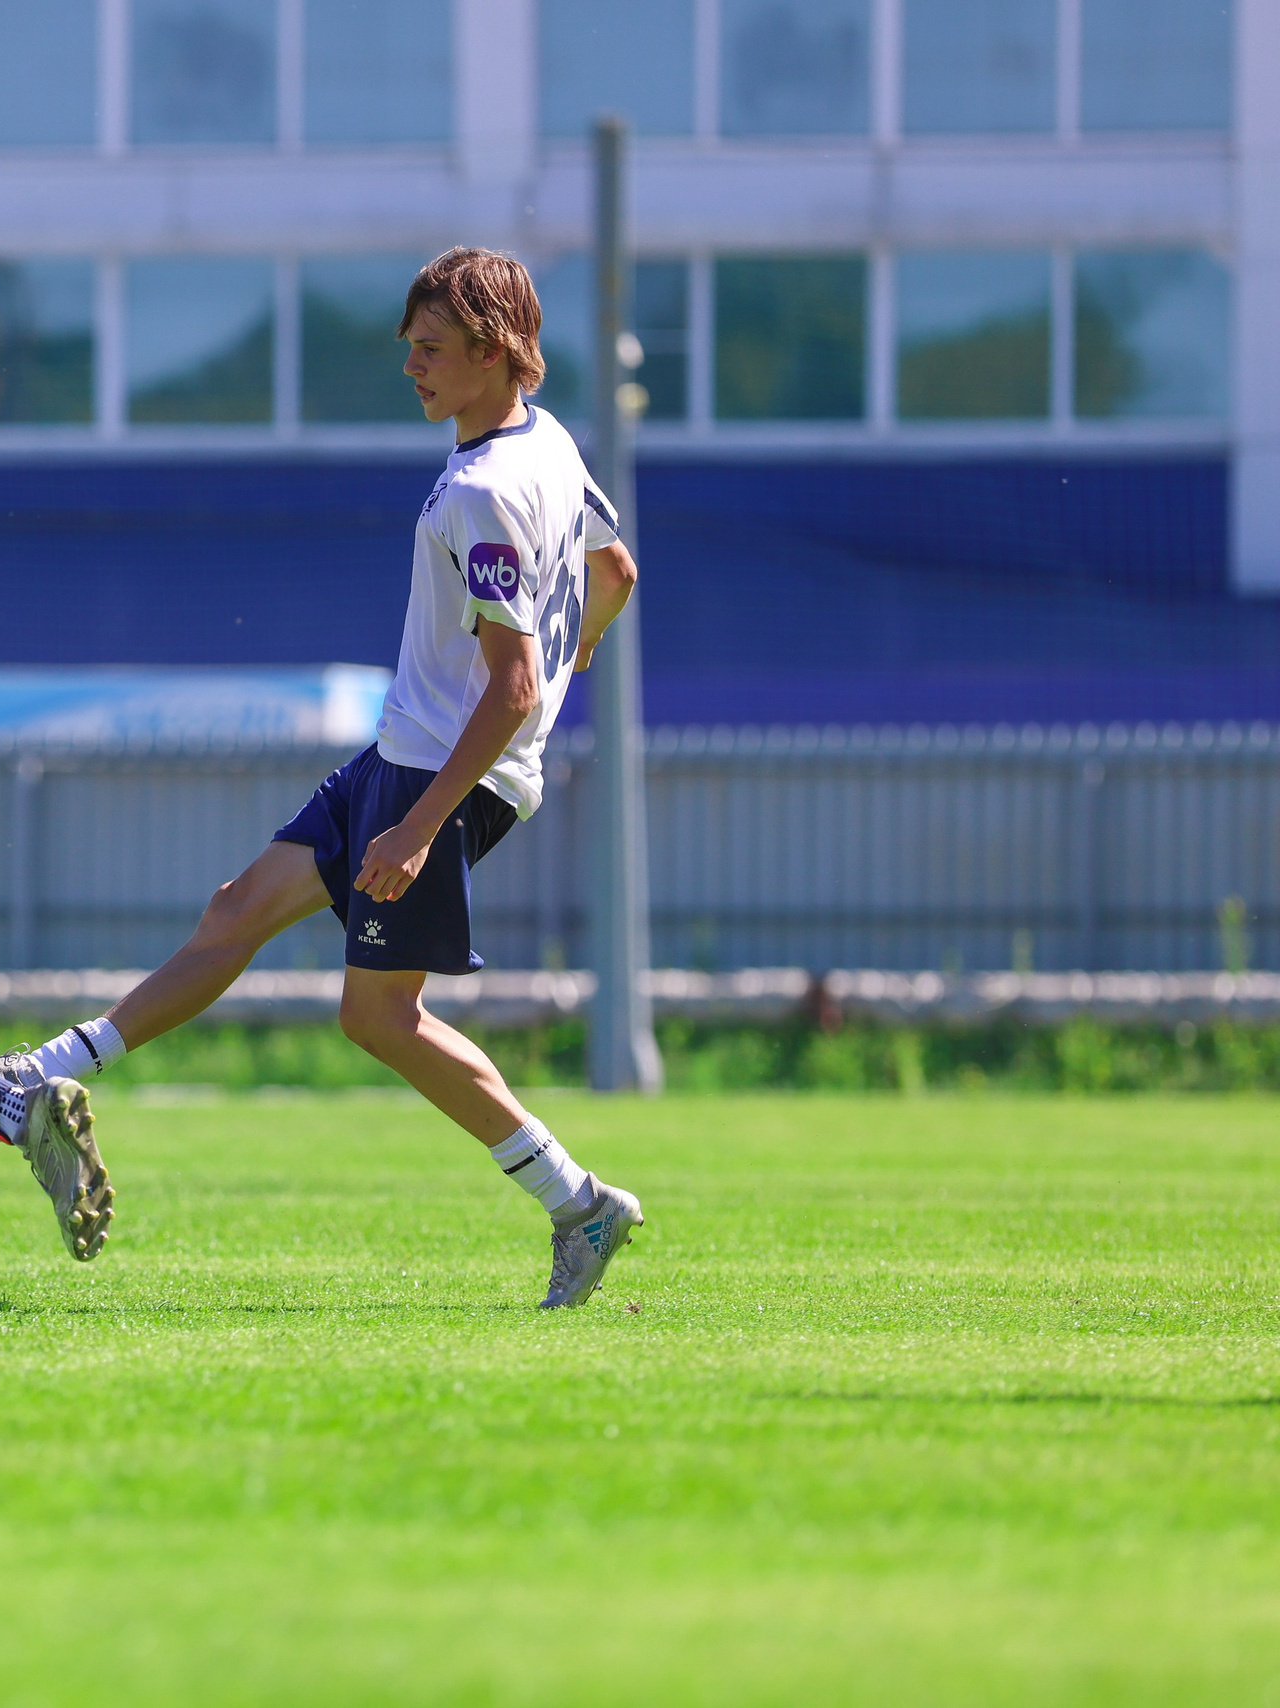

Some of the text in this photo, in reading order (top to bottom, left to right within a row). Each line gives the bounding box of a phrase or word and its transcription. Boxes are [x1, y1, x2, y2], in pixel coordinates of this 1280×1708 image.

[472, 556, 516, 587] wb
[358, 934, 387, 946] KELME
[600, 1213, 614, 1260] adidas
